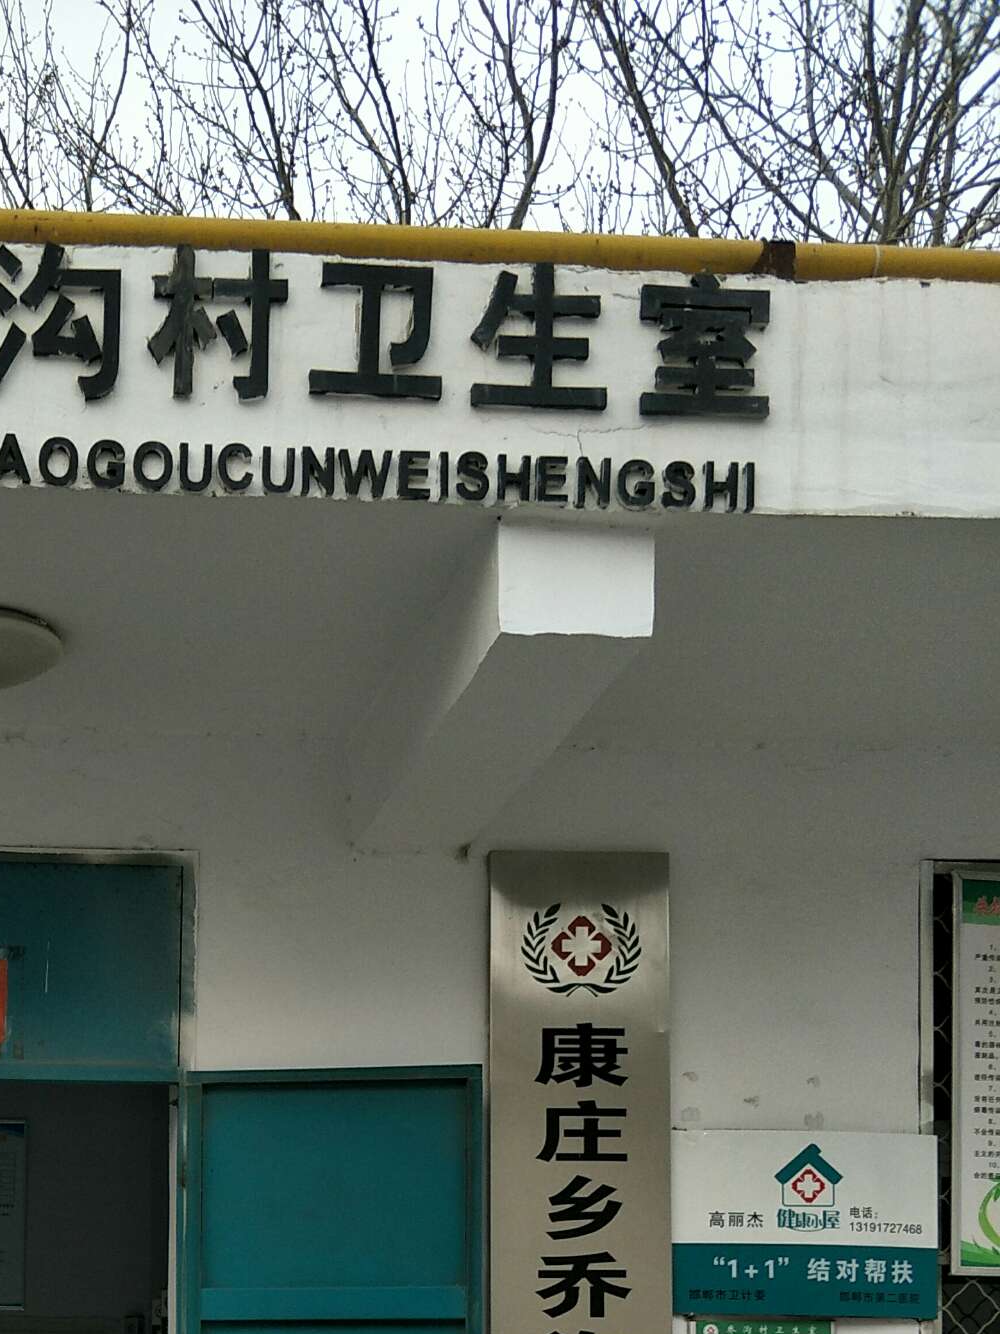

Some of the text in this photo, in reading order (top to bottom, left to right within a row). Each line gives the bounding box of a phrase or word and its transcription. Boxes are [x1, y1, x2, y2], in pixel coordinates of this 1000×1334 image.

[708, 1210, 764, 1229] 高丽杰
[850, 1221, 923, 1235] 13191727468
[807, 1258, 914, 1285] 结对帮扶
